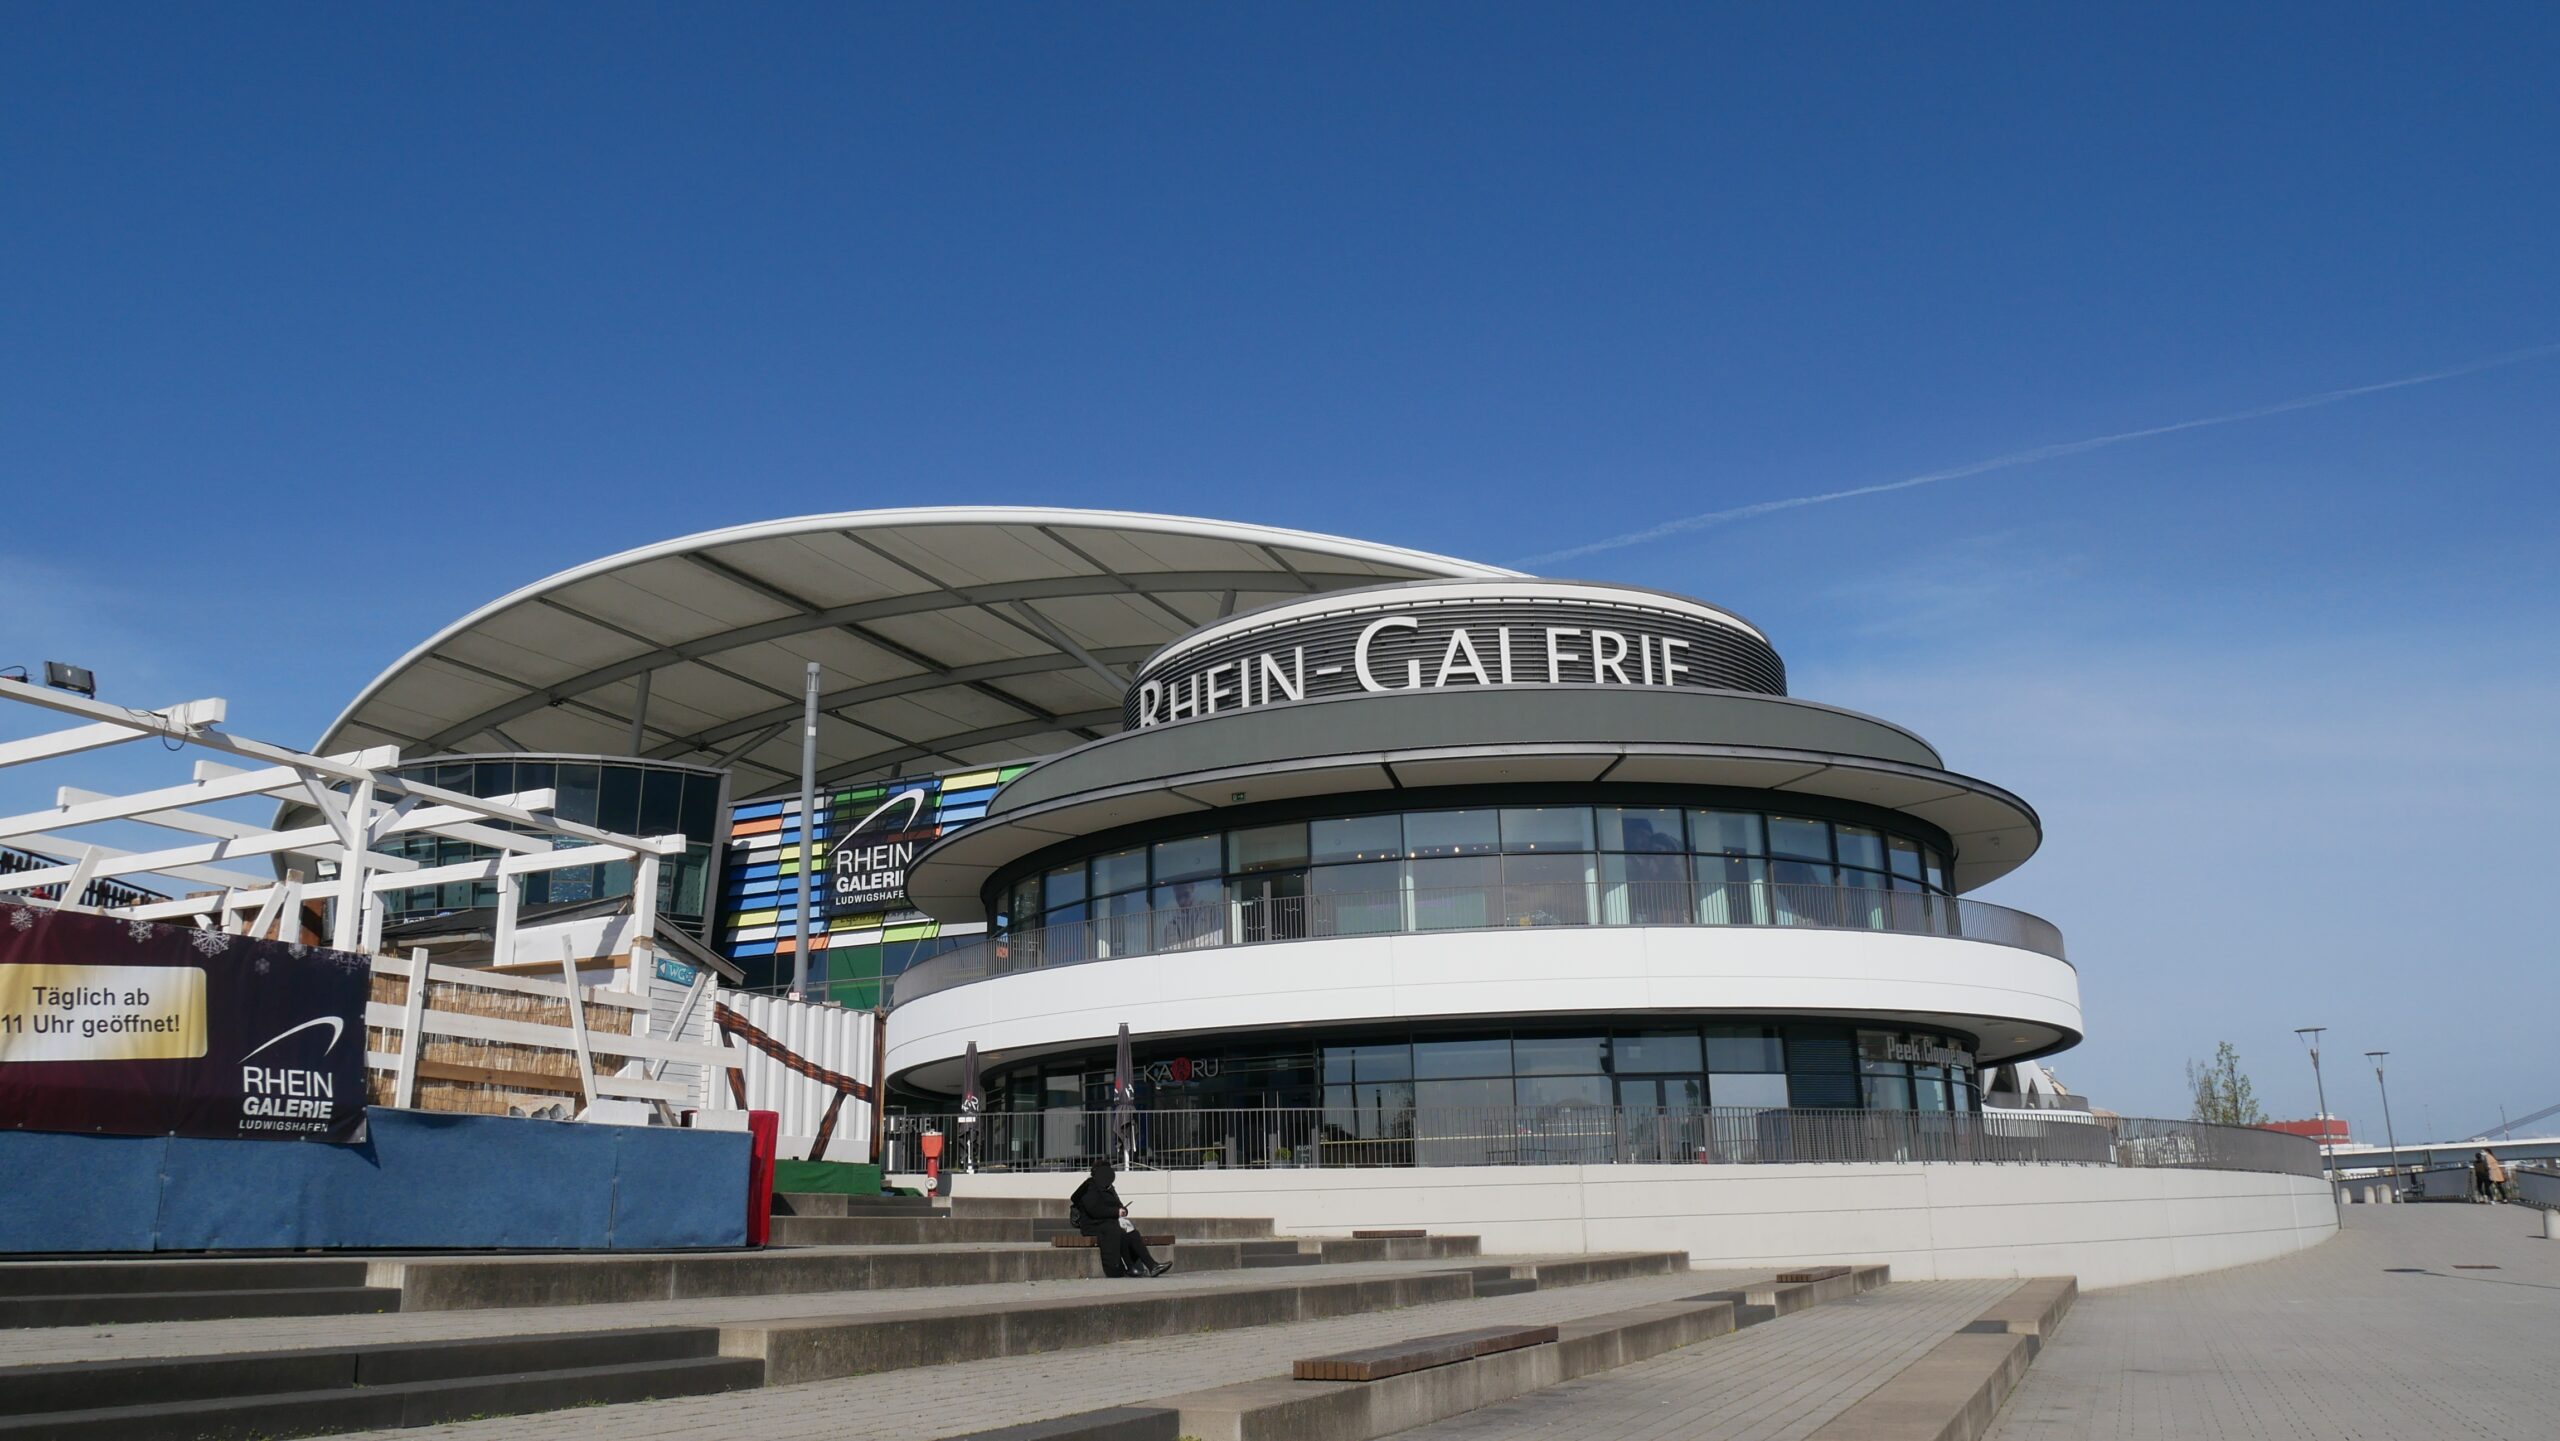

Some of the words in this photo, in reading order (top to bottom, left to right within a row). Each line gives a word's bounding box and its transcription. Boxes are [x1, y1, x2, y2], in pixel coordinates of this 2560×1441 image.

[836, 841, 913, 875] RHEIN
[836, 869, 905, 893] GALERI
[835, 889, 905, 906] LUDWIGSHAFE
[32, 986, 116, 1010] Täglich
[123, 988, 150, 1006] ab
[1, 1014, 23, 1033] 11
[33, 1014, 75, 1033] Uhr
[82, 1014, 181, 1038] geöffnet!
[242, 1065, 334, 1098] RHEIN
[242, 1096, 334, 1120] GALERIE
[238, 1119, 329, 1133] LUDWIGSHAFEN
